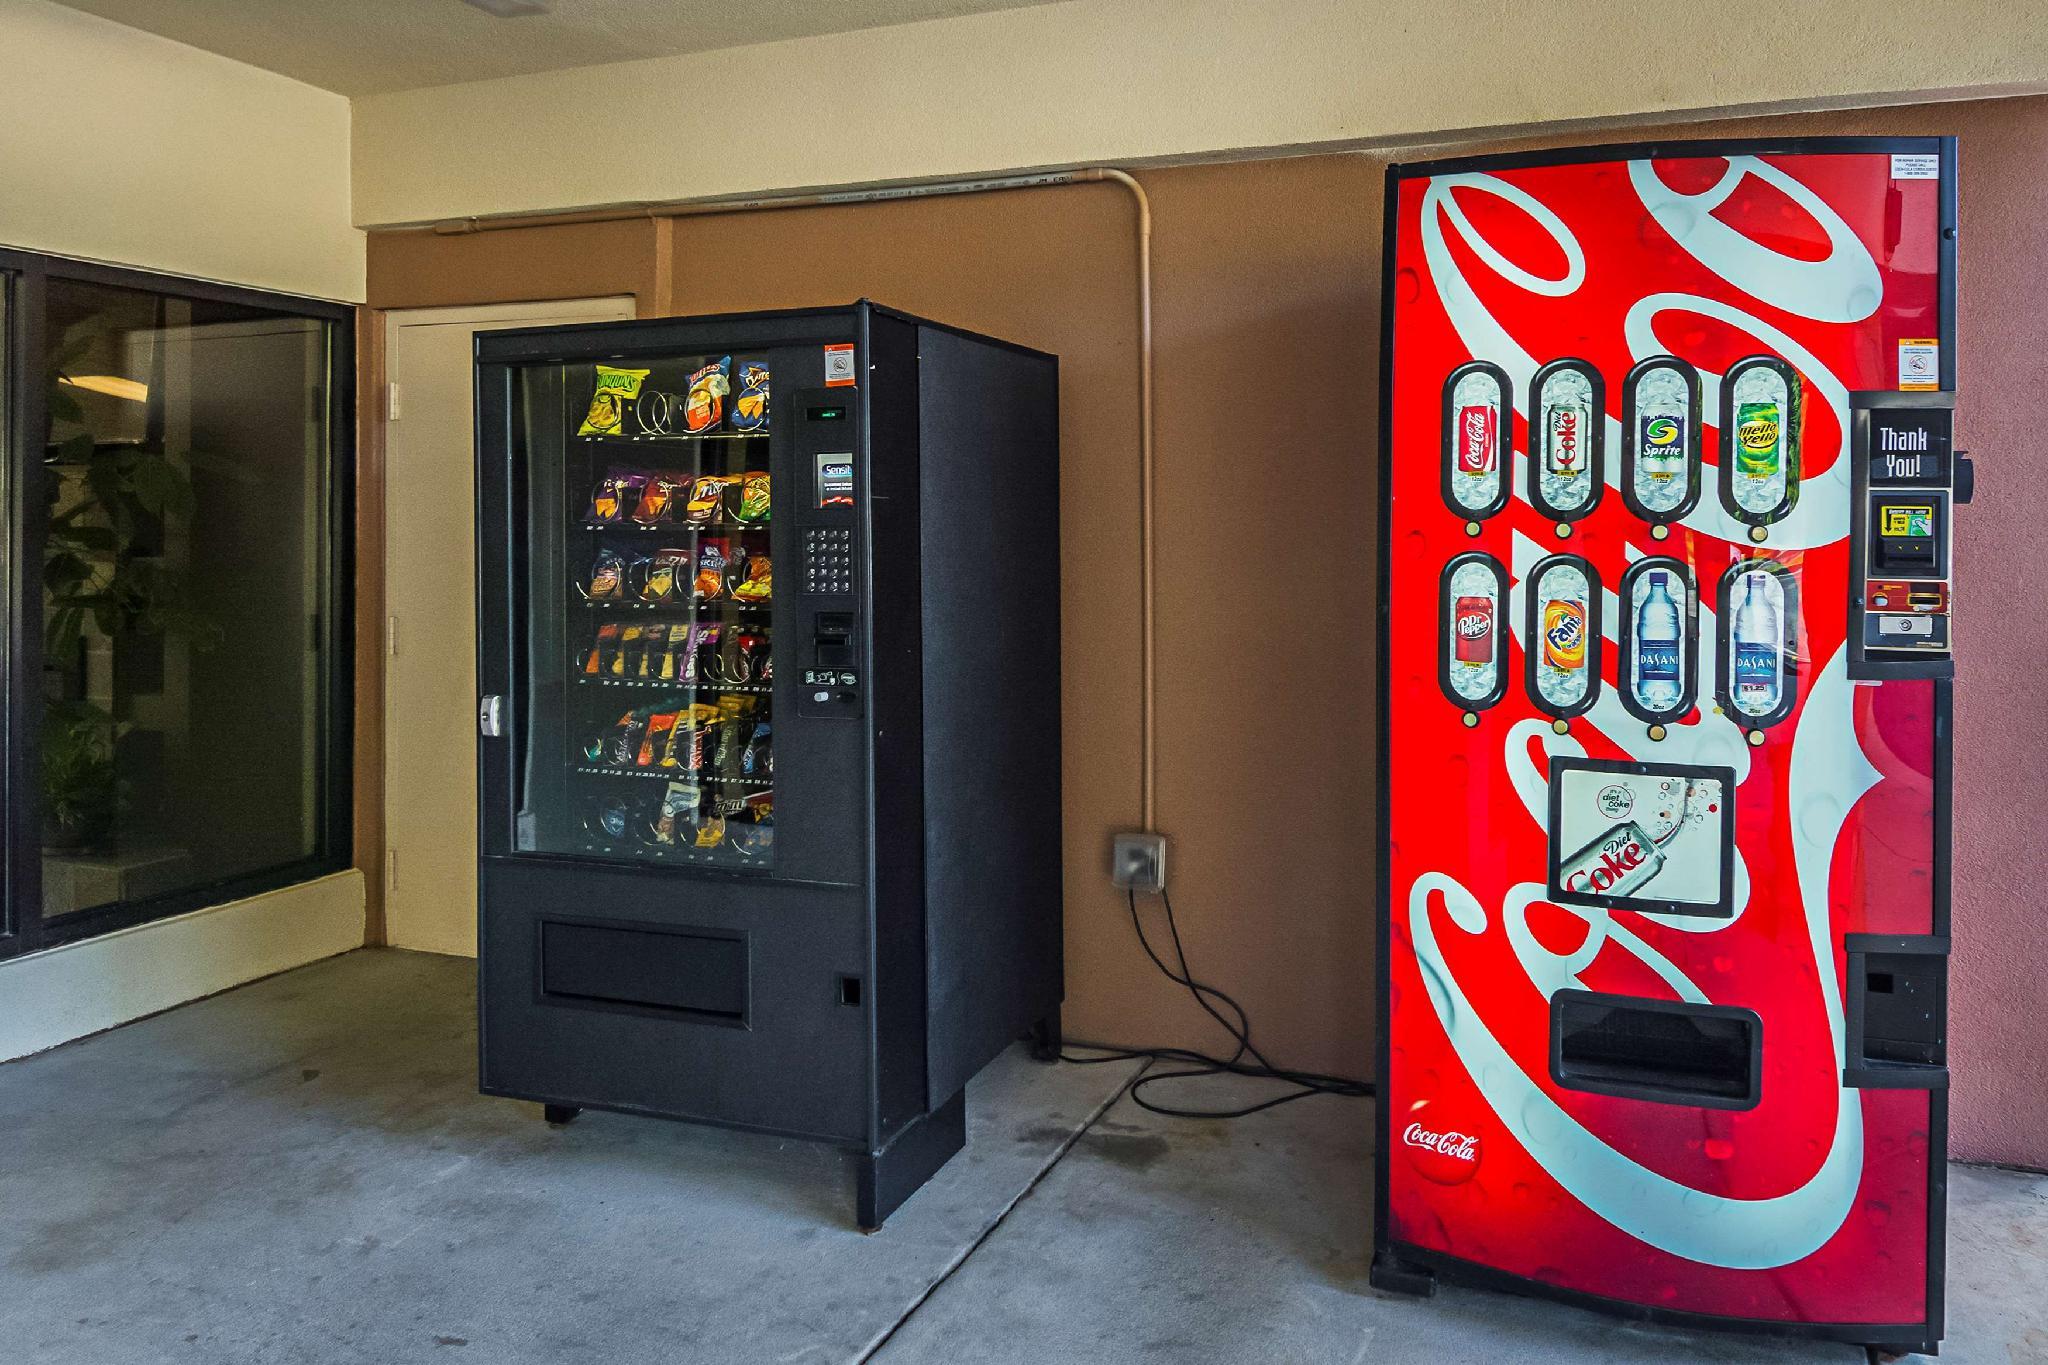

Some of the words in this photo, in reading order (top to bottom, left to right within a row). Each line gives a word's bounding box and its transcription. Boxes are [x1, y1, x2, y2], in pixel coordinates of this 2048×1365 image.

[1556, 412, 1576, 465] Coke
[1880, 427, 1928, 451] Thank
[1643, 443, 1682, 458] Sprite
[1886, 454, 1921, 478] You!
[1461, 616, 1490, 636] Pepper
[1469, 614, 1482, 625] Dr
[1547, 615, 1583, 651] Fanta
[1640, 652, 1679, 667] DASANI
[1737, 655, 1776, 670] DASANI
[1602, 793, 1620, 802] diet
[1608, 800, 1631, 809] coke
[1603, 831, 1632, 855] Diet
[1566, 843, 1649, 895] Coke
[1403, 1122, 1480, 1162] Coca-Cola
